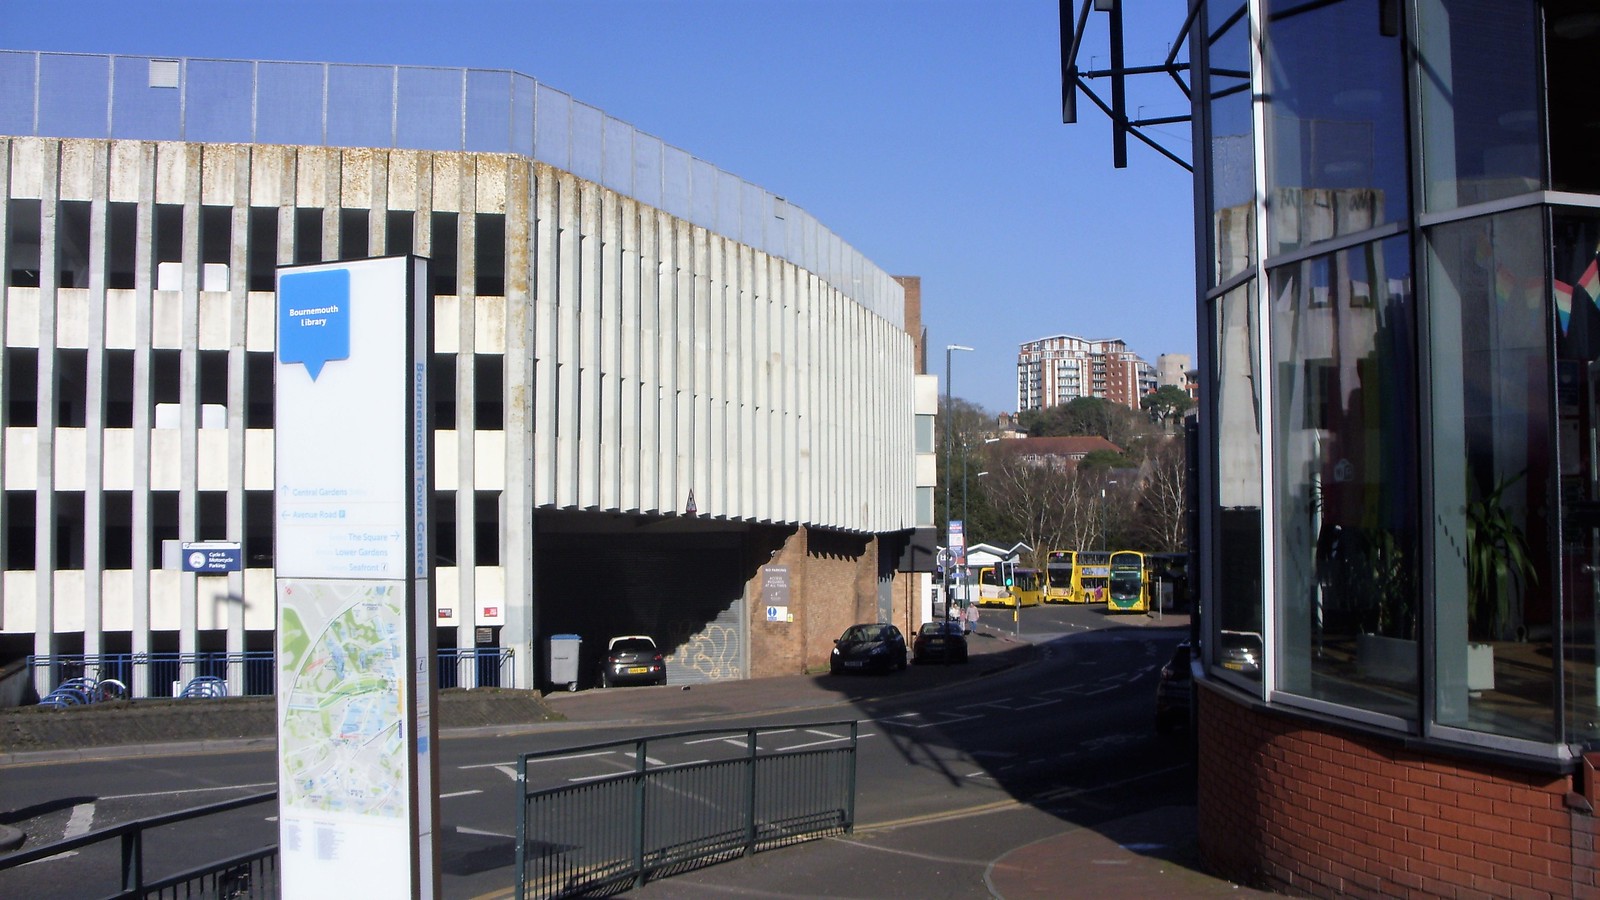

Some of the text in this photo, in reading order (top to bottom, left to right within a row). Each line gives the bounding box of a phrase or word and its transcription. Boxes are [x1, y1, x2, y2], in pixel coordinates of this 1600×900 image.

[289, 305, 339, 317] Bournemouth
[300, 317, 327, 327] Library
[416, 363, 425, 575] Bournemouth Town Centre
[292, 487, 317, 497] Central
[319, 487, 347, 497] Gardens
[292, 510, 337, 519] Avenue Road
[348, 532, 362, 541] The
[364, 532, 388, 543] Square
[335, 547, 357, 556] Lower
[358, 547, 388, 557] Gardens
[349, 562, 379, 572] Seafront
